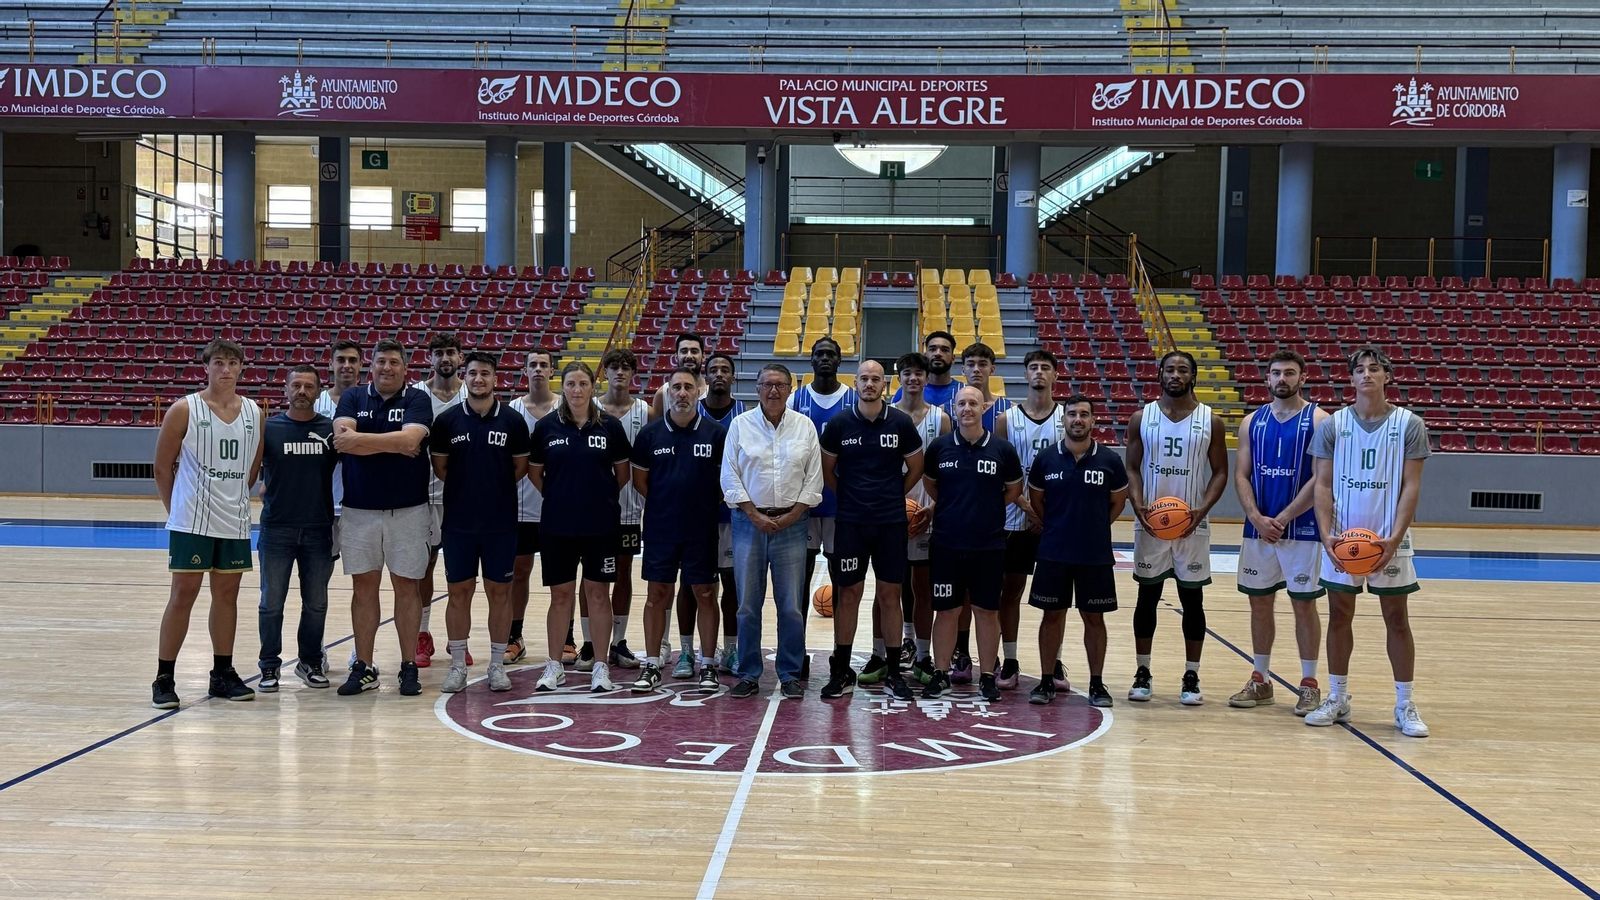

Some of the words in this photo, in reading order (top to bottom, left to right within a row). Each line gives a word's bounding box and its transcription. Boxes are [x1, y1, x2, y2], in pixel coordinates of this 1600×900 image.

[14, 68, 167, 99] IMDECO
[320, 79, 398, 94] AYUNTAMIENTO
[525, 75, 682, 107] IMDECO
[779, 79, 838, 92] PALACIO
[842, 80, 916, 92] MUNICIPAL
[920, 80, 988, 92] DEPORTES
[1141, 78, 1306, 110] IMDECO
[1437, 86, 1519, 101] AYUNTAMIENTO
[320, 95, 336, 109] DE
[337, 94, 387, 110] CÓRDOBA
[1437, 103, 1450, 118] DE
[1453, 101, 1507, 118] CÓRDOBA
[11, 104, 58, 115] Municipal
[60, 105, 73, 114] de
[76, 105, 120, 116] Deportes
[123, 105, 165, 115] Córdoba
[478, 111, 519, 121] Instituto
[522, 112, 570, 123] Municipal
[573, 113, 586, 122] de
[589, 113, 634, 124] Deportes
[637, 113, 680, 123] Córdoba
[764, 96, 860, 125] VISTA
[871, 96, 1008, 125] ALEGRE
[1092, 116, 1135, 126] Instituto
[1137, 116, 1188, 127] Municipal
[1191, 116, 1204, 126] de
[1207, 116, 1255, 127] Deportes
[1257, 115, 1303, 126] Córdoba
[369, 153, 382, 167] G
[887, 163, 898, 177] H
[487, 430, 508, 447] CCB
[548, 438, 565, 447] coto
[588, 435, 607, 450] CCB
[841, 437, 858, 446] coto
[880, 434, 899, 449] CCB
[220, 438, 239, 460] 00
[283, 442, 323, 455] PUMA
[653, 447, 671, 455] coto
[693, 444, 713, 458] CCB
[1163, 436, 1183, 457] 35
[1361, 448, 1377, 470] 10
[208, 468, 245, 481] Sepisur
[977, 460, 997, 475] CCB
[1154, 465, 1191, 477] Sepisur
[1260, 465, 1296, 478] Sepisur
[1084, 470, 1104, 485] CCB
[1347, 478, 1388, 491] Sepisur
[622, 533, 638, 547] 22
[601, 557, 616, 573] CCB
[841, 557, 858, 572] CCB
[933, 583, 953, 597] CCB
